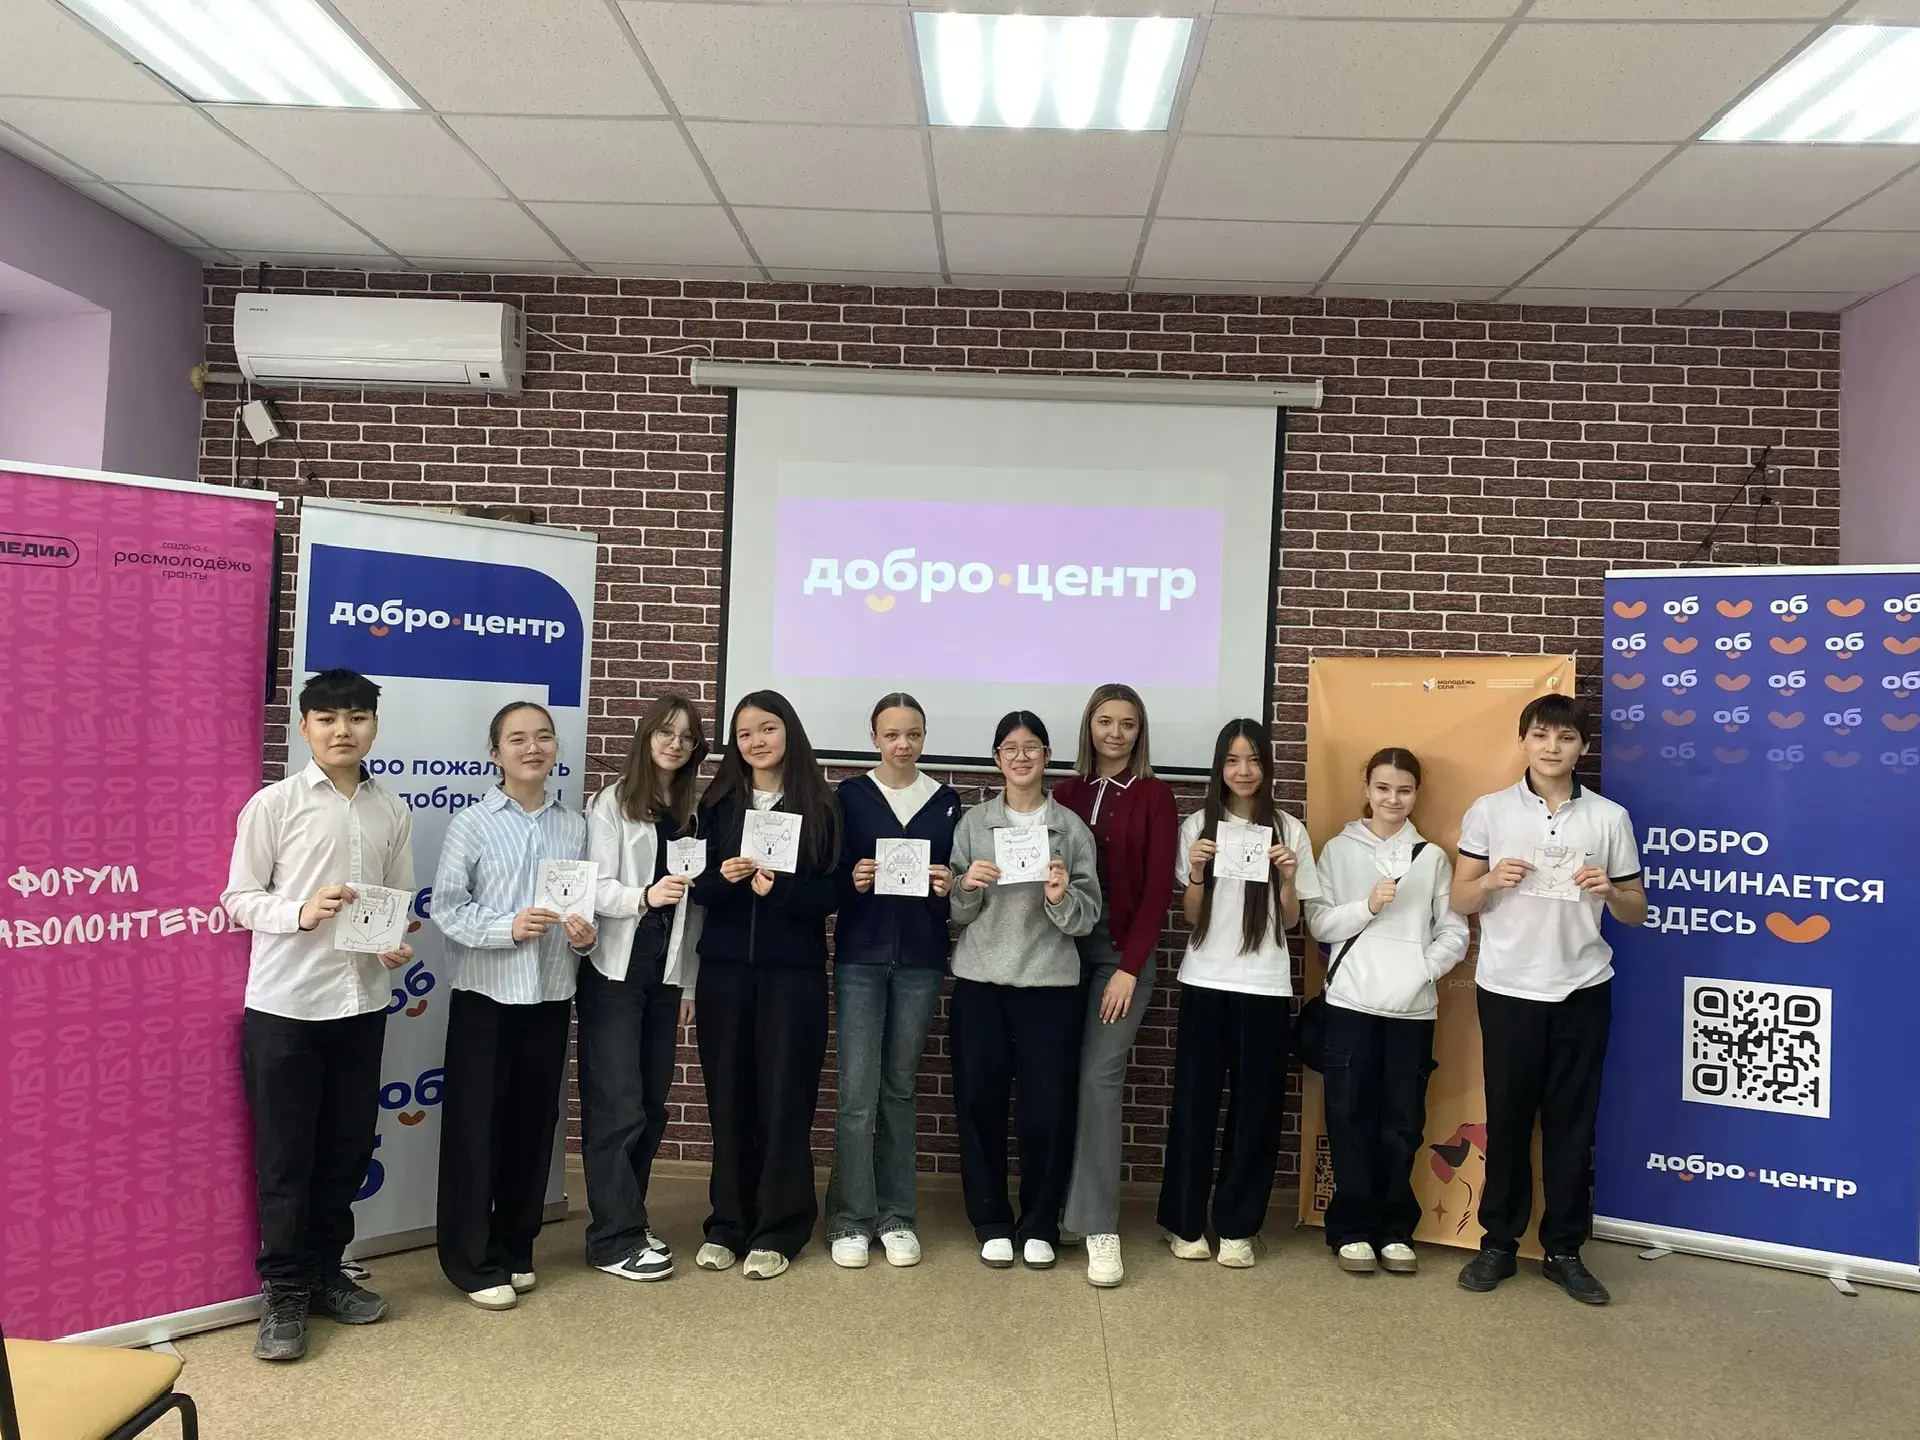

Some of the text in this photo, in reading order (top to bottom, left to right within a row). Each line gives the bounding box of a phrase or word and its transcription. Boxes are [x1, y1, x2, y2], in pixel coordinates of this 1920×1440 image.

[114, 551, 251, 572] росмолодёжь
[162, 569, 208, 581] гранты
[412, 759, 571, 777] пожалть
[1643, 827, 1769, 856] ДОБРО
[8, 865, 139, 898] ФОРУМ
[1642, 866, 1884, 903] НАЧИНАЕТСЯ
[1642, 904, 1757, 935] ЗДЕСЬ
